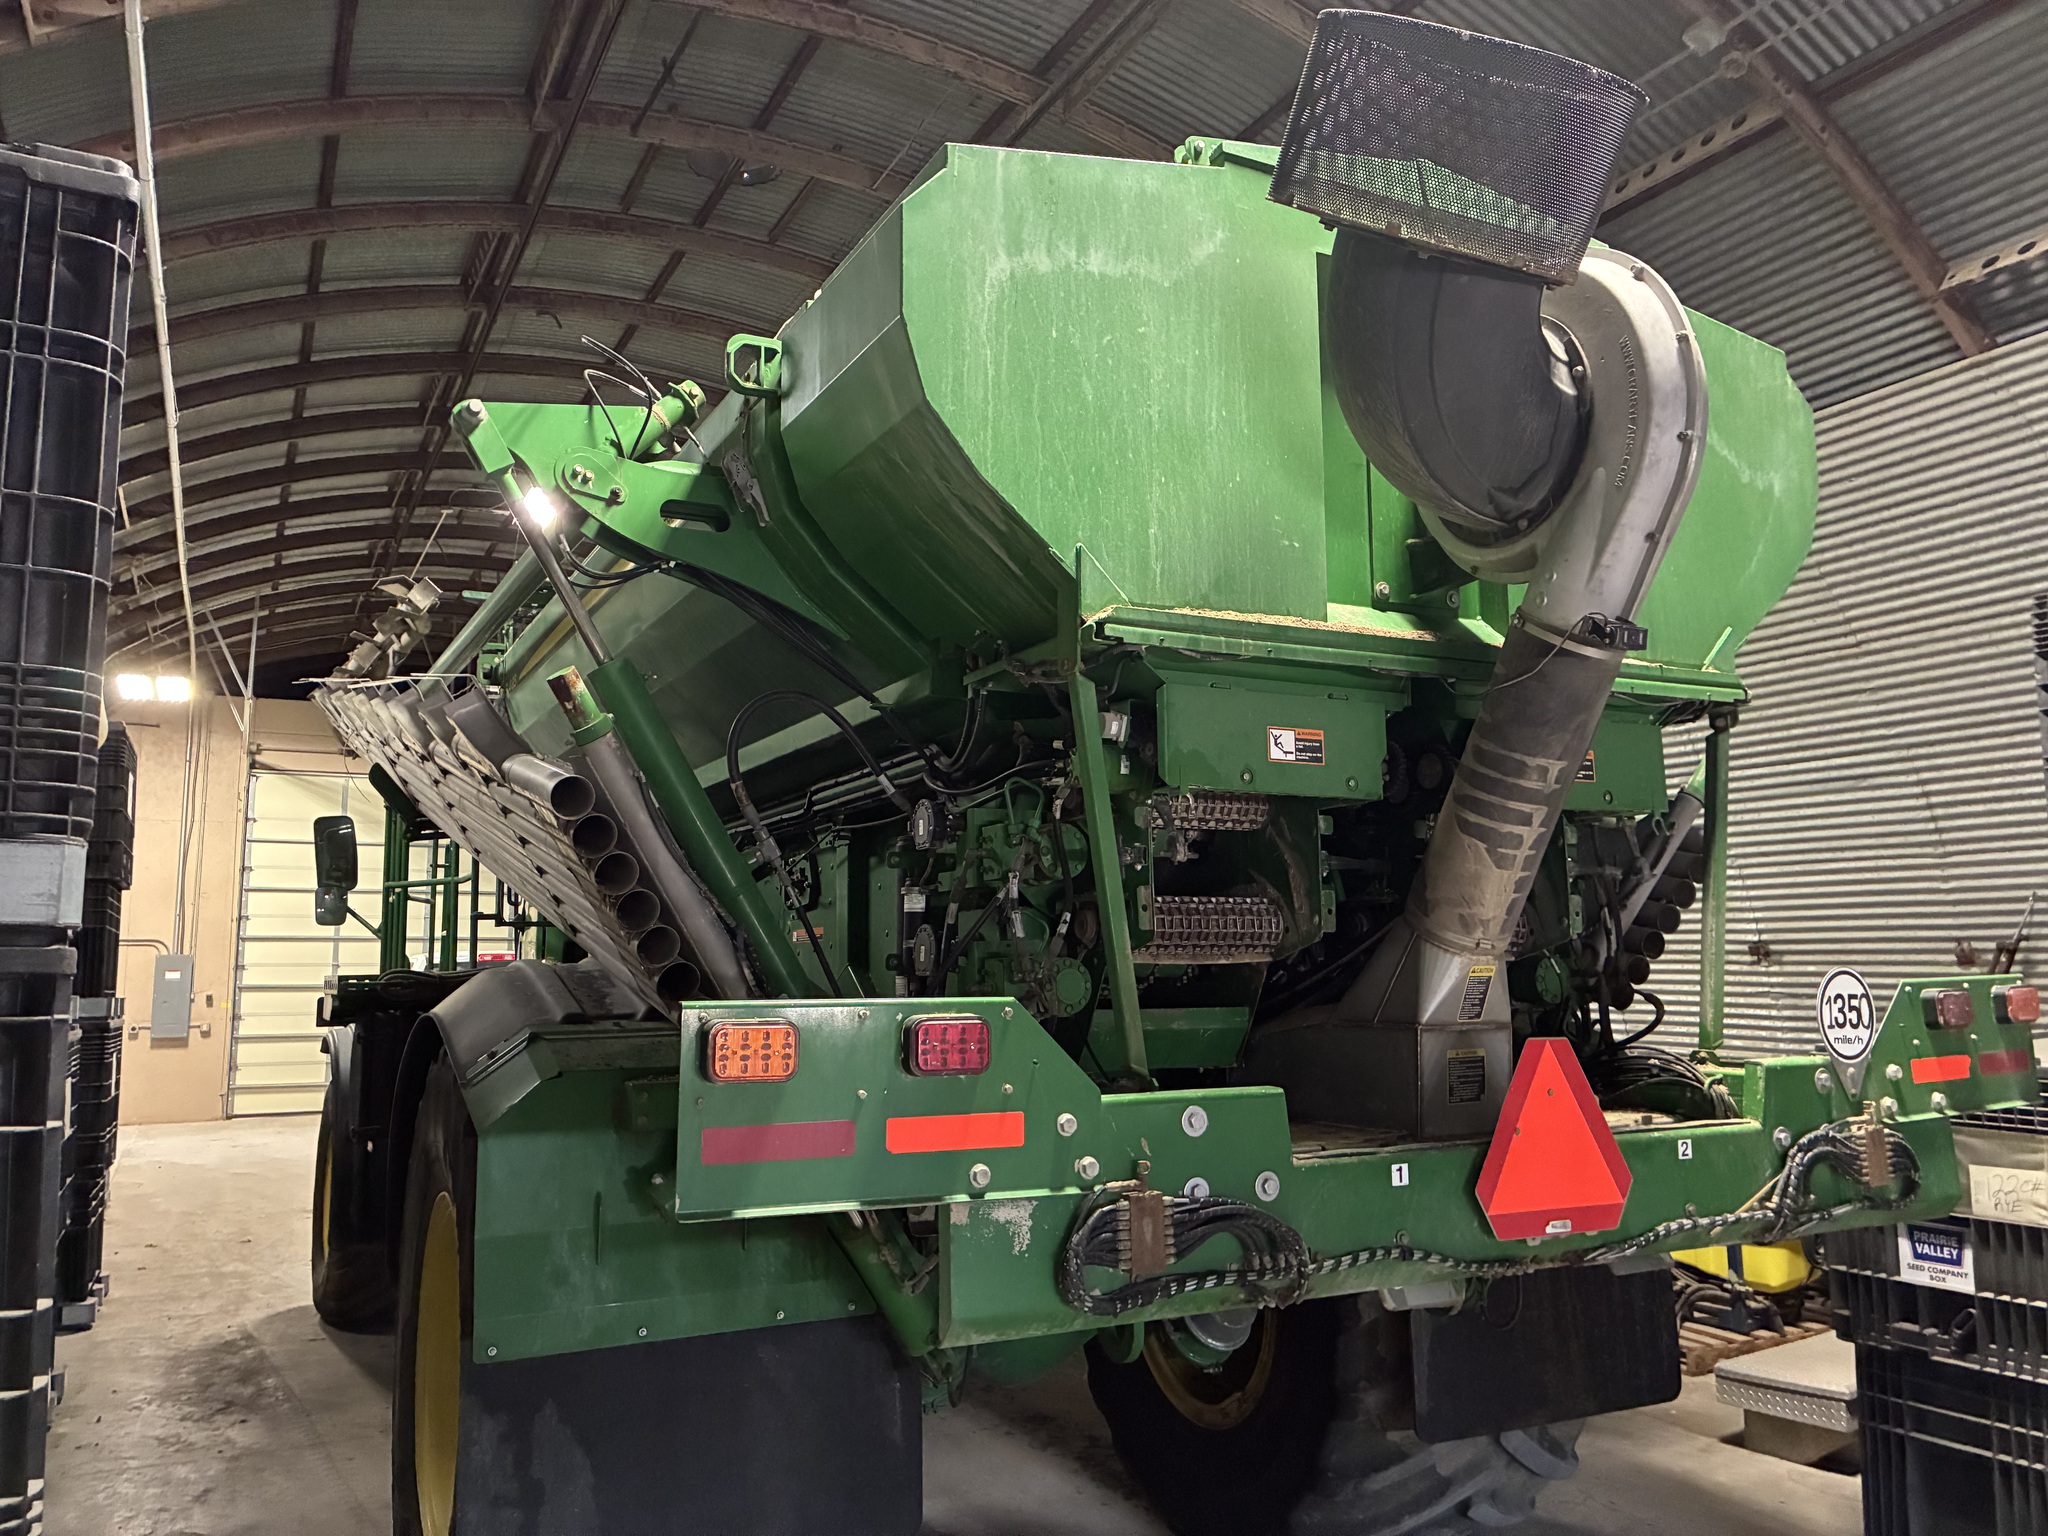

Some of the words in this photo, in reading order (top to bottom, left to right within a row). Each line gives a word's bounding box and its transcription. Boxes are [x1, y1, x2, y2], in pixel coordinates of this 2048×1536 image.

[1825, 993, 1871, 1030] 1350
[1834, 1035, 1864, 1045] mile/h
[1680, 1141, 1690, 1157] 2
[1395, 1166, 1404, 1183] 1
[1913, 1230, 1959, 1247] PRAIRIE
[1915, 1243, 1959, 1260] VALLEY
[1907, 1262, 1926, 1272] SEED
[1927, 1266, 1969, 1279] COMPANY
[1929, 1274, 1947, 1284] BOX
